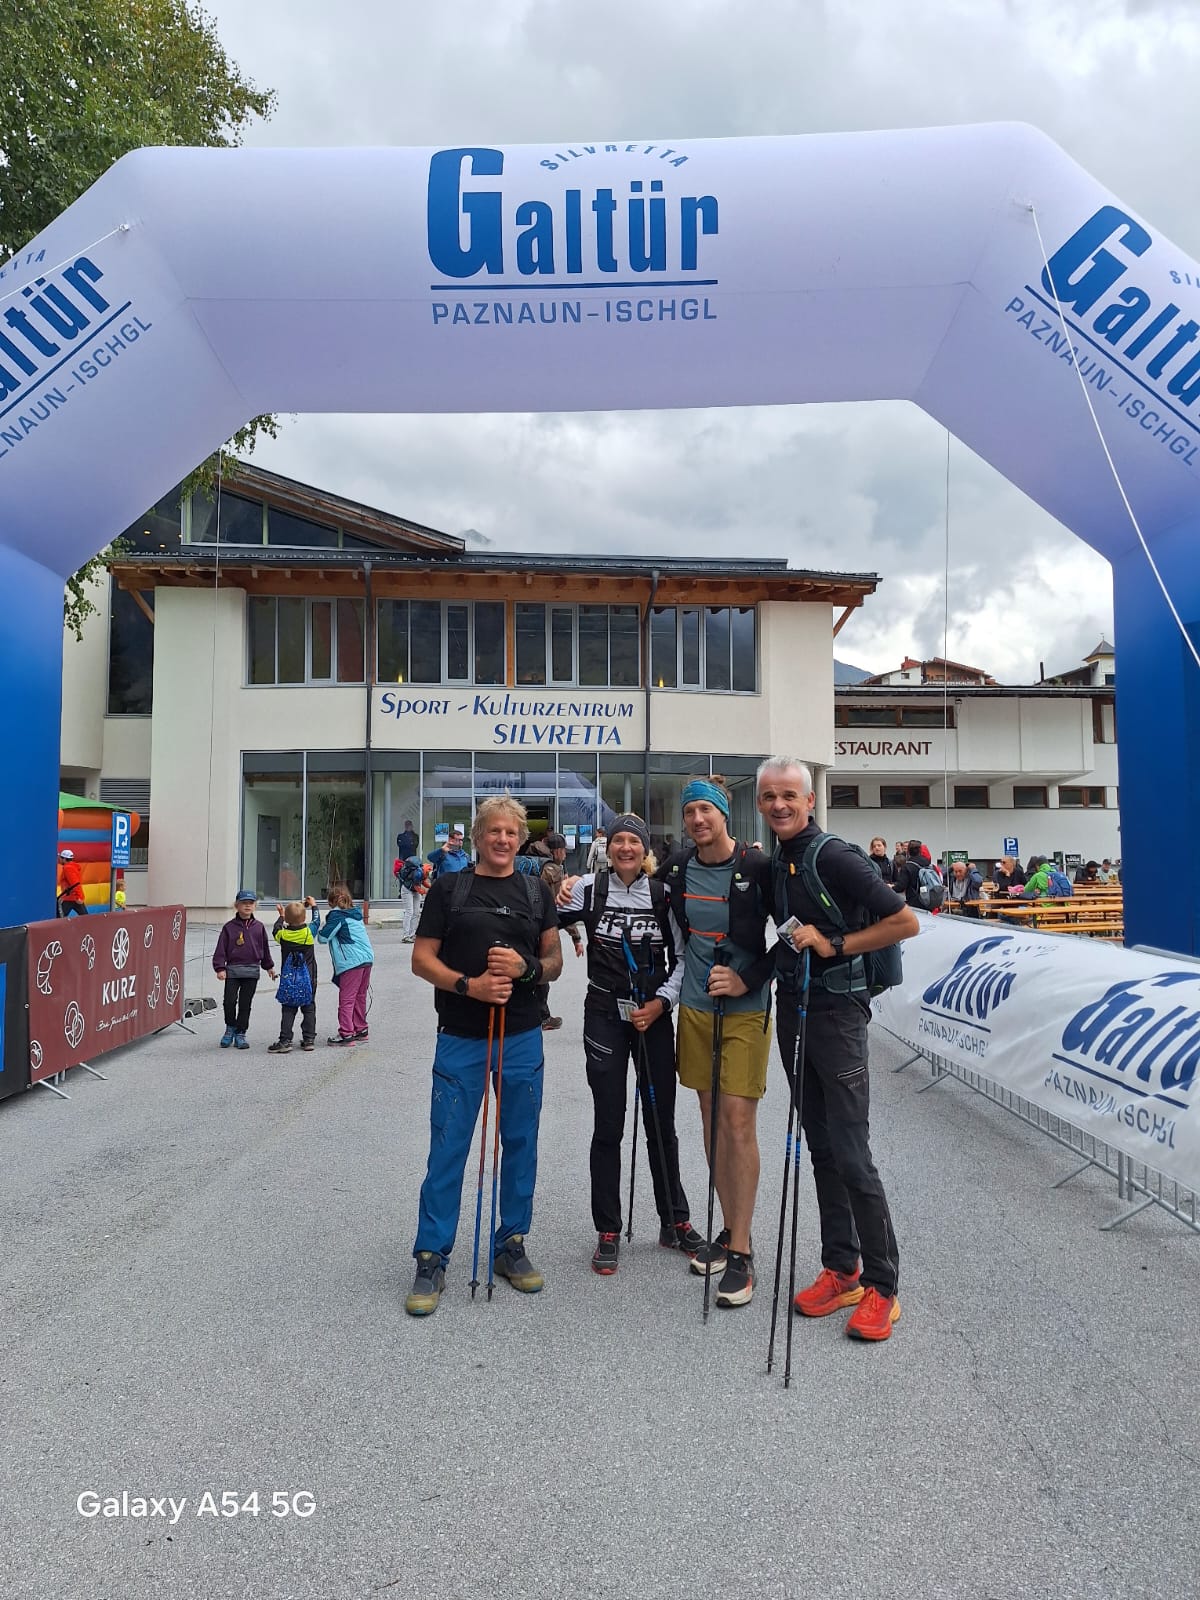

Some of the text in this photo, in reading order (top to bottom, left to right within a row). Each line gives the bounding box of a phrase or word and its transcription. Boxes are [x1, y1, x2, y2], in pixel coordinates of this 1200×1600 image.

[540, 144, 689, 171] SILVRETTA
[427, 147, 719, 279] Galtür
[432, 298, 718, 325] PAZNAUN-ISCHGL
[0, 256, 111, 402] ltür
[1004, 296, 1198, 466] PAZNAUN-ISCHGL
[493, 723, 622, 745] SILVRETTA
[115, 815, 128, 848] P
[1006, 838, 1016, 851] P
[102, 974, 137, 1006] KURZ
